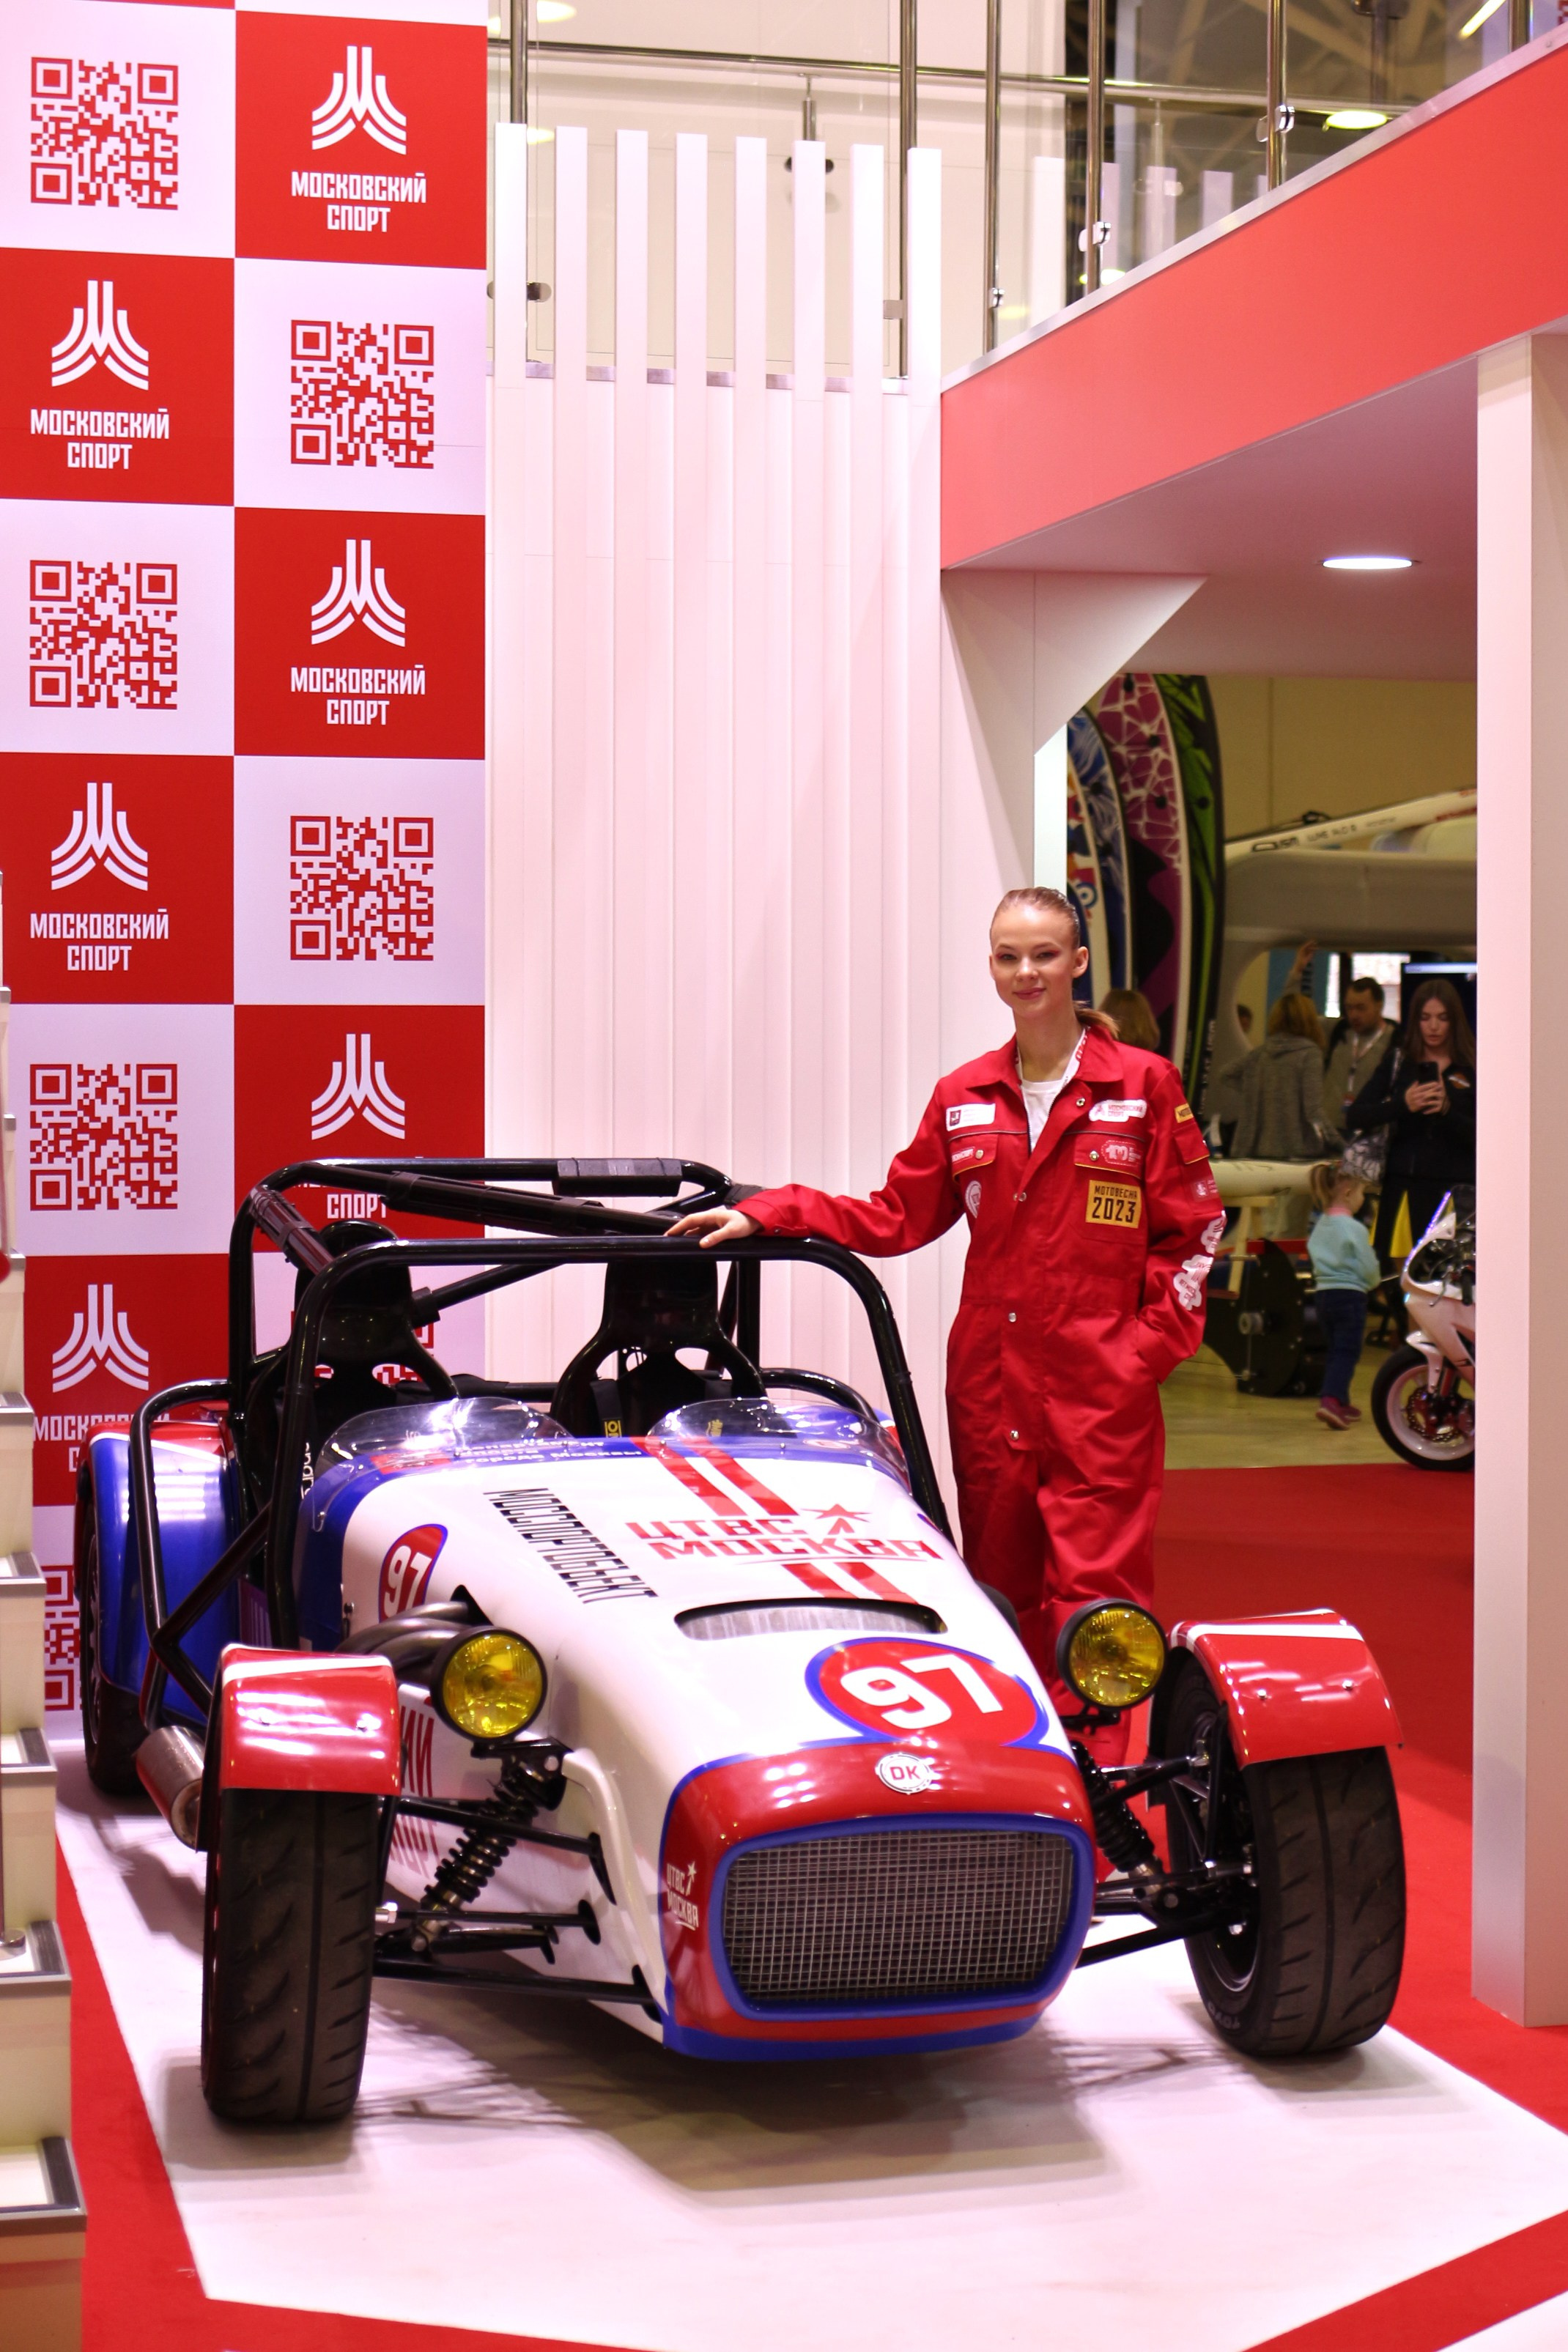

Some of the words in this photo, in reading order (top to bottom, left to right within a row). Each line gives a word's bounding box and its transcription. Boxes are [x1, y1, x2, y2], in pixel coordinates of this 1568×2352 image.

[292, 171, 426, 204] МОСКОВСКИЙ
[327, 204, 391, 233] СПОРТ
[31, 408, 170, 440] МОСКОВСКИЙ
[67, 443, 133, 470] СПОРТ
[291, 665, 426, 695] МОСКОВСКИЙ
[327, 700, 390, 725] СПОРТ
[30, 909, 169, 940] МОСКОВСКИЙ
[67, 946, 132, 971] СПОРТ
[1092, 1197, 1136, 1224] 2023
[625, 1519, 808, 1539] ЦТВС
[648, 1537, 944, 1560] МОСКВА
[384, 1545, 433, 1615] 97
[840, 1654, 1003, 1729] 97
[890, 1765, 921, 1781] DK
